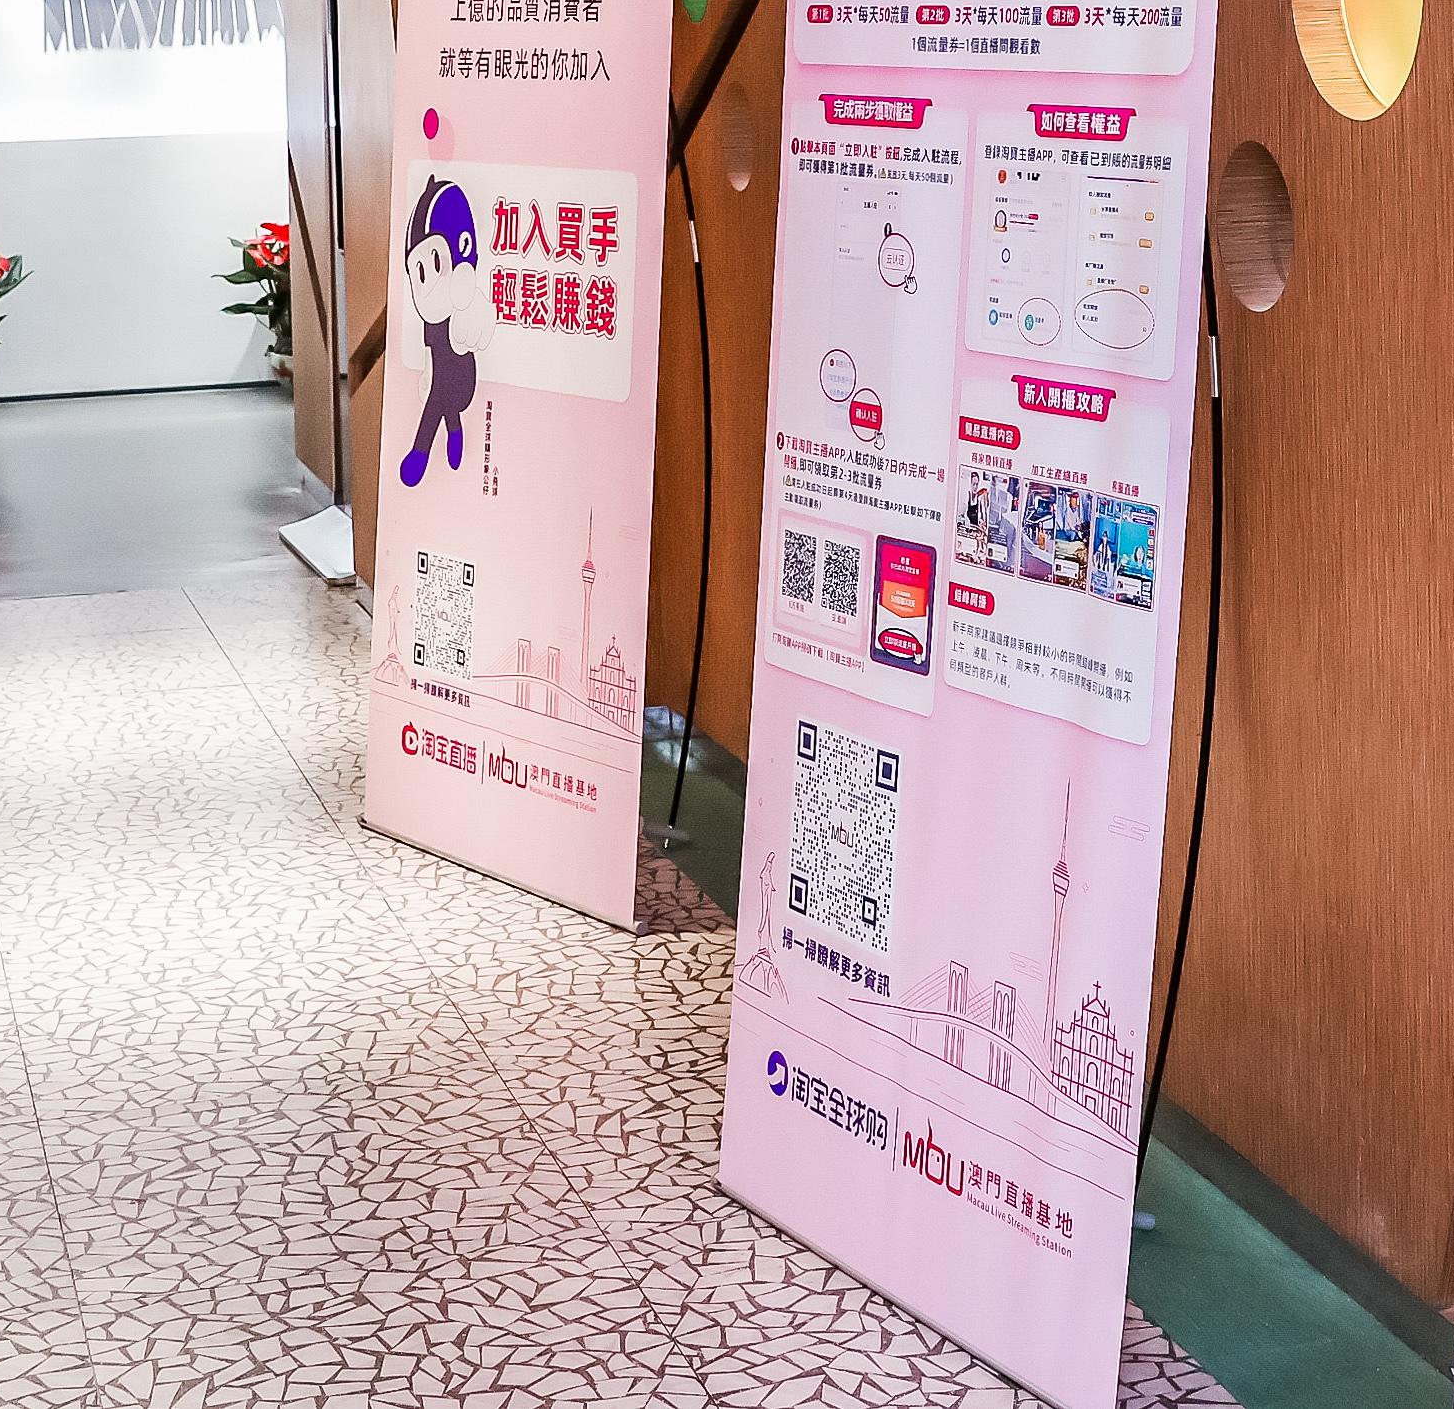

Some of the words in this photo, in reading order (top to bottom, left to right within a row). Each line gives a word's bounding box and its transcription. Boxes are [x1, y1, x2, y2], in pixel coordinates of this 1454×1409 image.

[439, 47, 610, 82] 就等有眼光的你加入
[1041, 111, 1121, 135] 如何查看權益
[491, 196, 620, 266] 加入買手
[491, 265, 617, 339] 輕鬆賺錢
[1023, 382, 1104, 415] 新人開播攻略
[421, 728, 477, 775] 淘宝直播
[530, 763, 597, 801] 澳門直播基地
[790, 1066, 888, 1151] 淘宝全球购
[967, 1160, 1074, 1239] 澳門直播基地
[1041, 1229, 1073, 1259] Station
